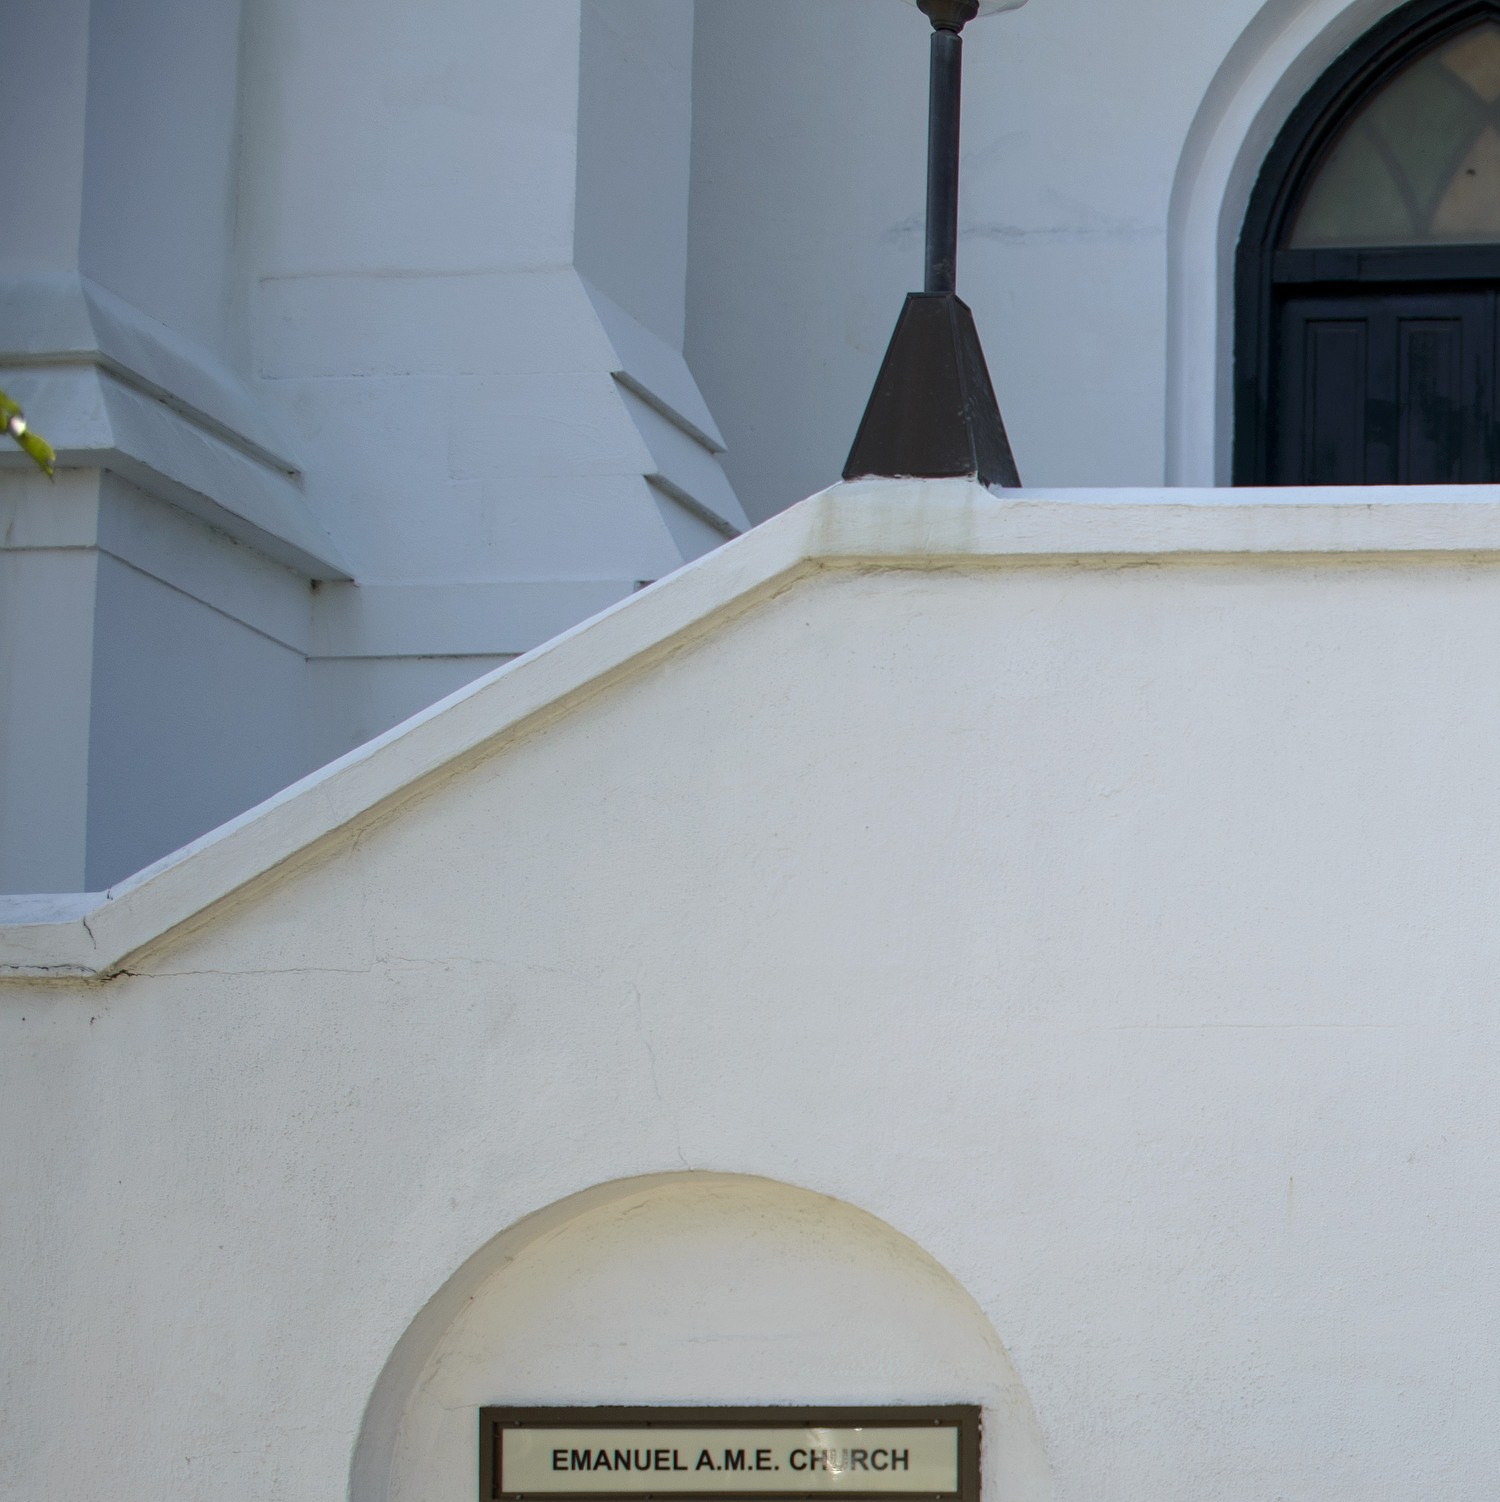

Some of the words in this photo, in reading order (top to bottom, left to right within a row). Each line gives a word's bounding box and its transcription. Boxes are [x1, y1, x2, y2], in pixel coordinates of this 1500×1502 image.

[552, 1448, 689, 1472] EMANUEL
[695, 1448, 780, 1472] A.M.E.
[789, 1448, 910, 1472] CHURCH
